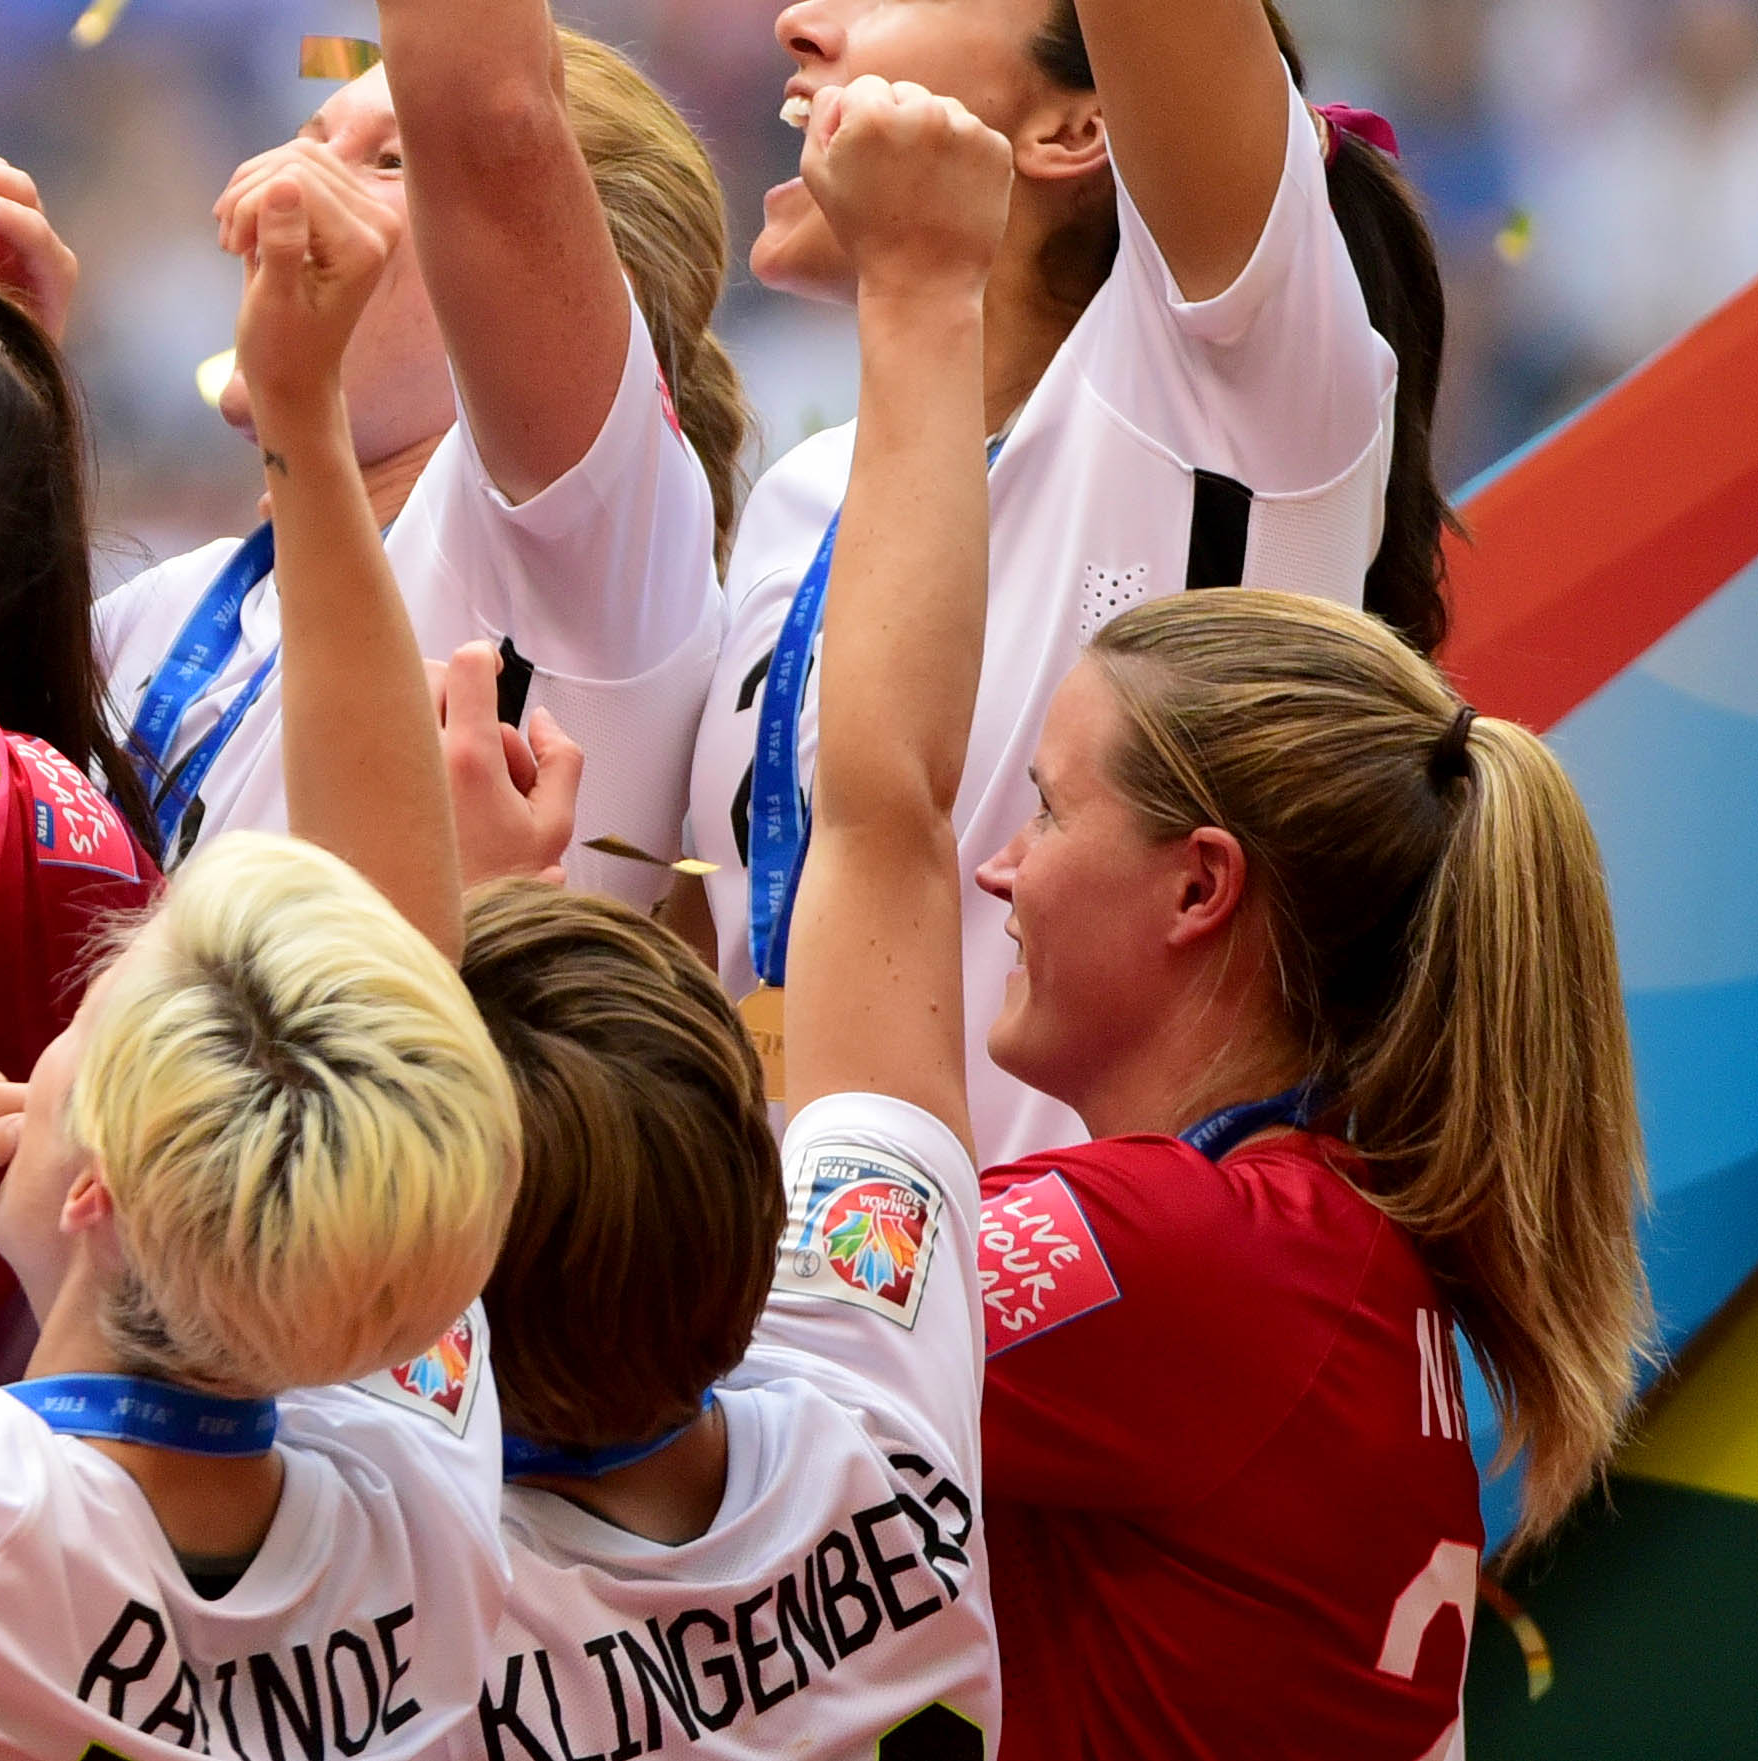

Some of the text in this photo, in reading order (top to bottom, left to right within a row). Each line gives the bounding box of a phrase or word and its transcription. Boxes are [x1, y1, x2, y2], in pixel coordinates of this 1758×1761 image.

[767, 720, 782, 767] FIFA
[17, 743, 93, 855] GOALS
[766, 794, 782, 842] FIFA
[36, 804, 50, 844] FIFA
[1190, 1107, 1236, 1151] FIFA
[818, 1164, 860, 1180] FIFA
[858, 1192, 919, 1221] CANADA
[888, 1187, 922, 1208] 2015
[1003, 1196, 1082, 1269] LIVE
[478, 1453, 973, 1761] KLINGENBERG
